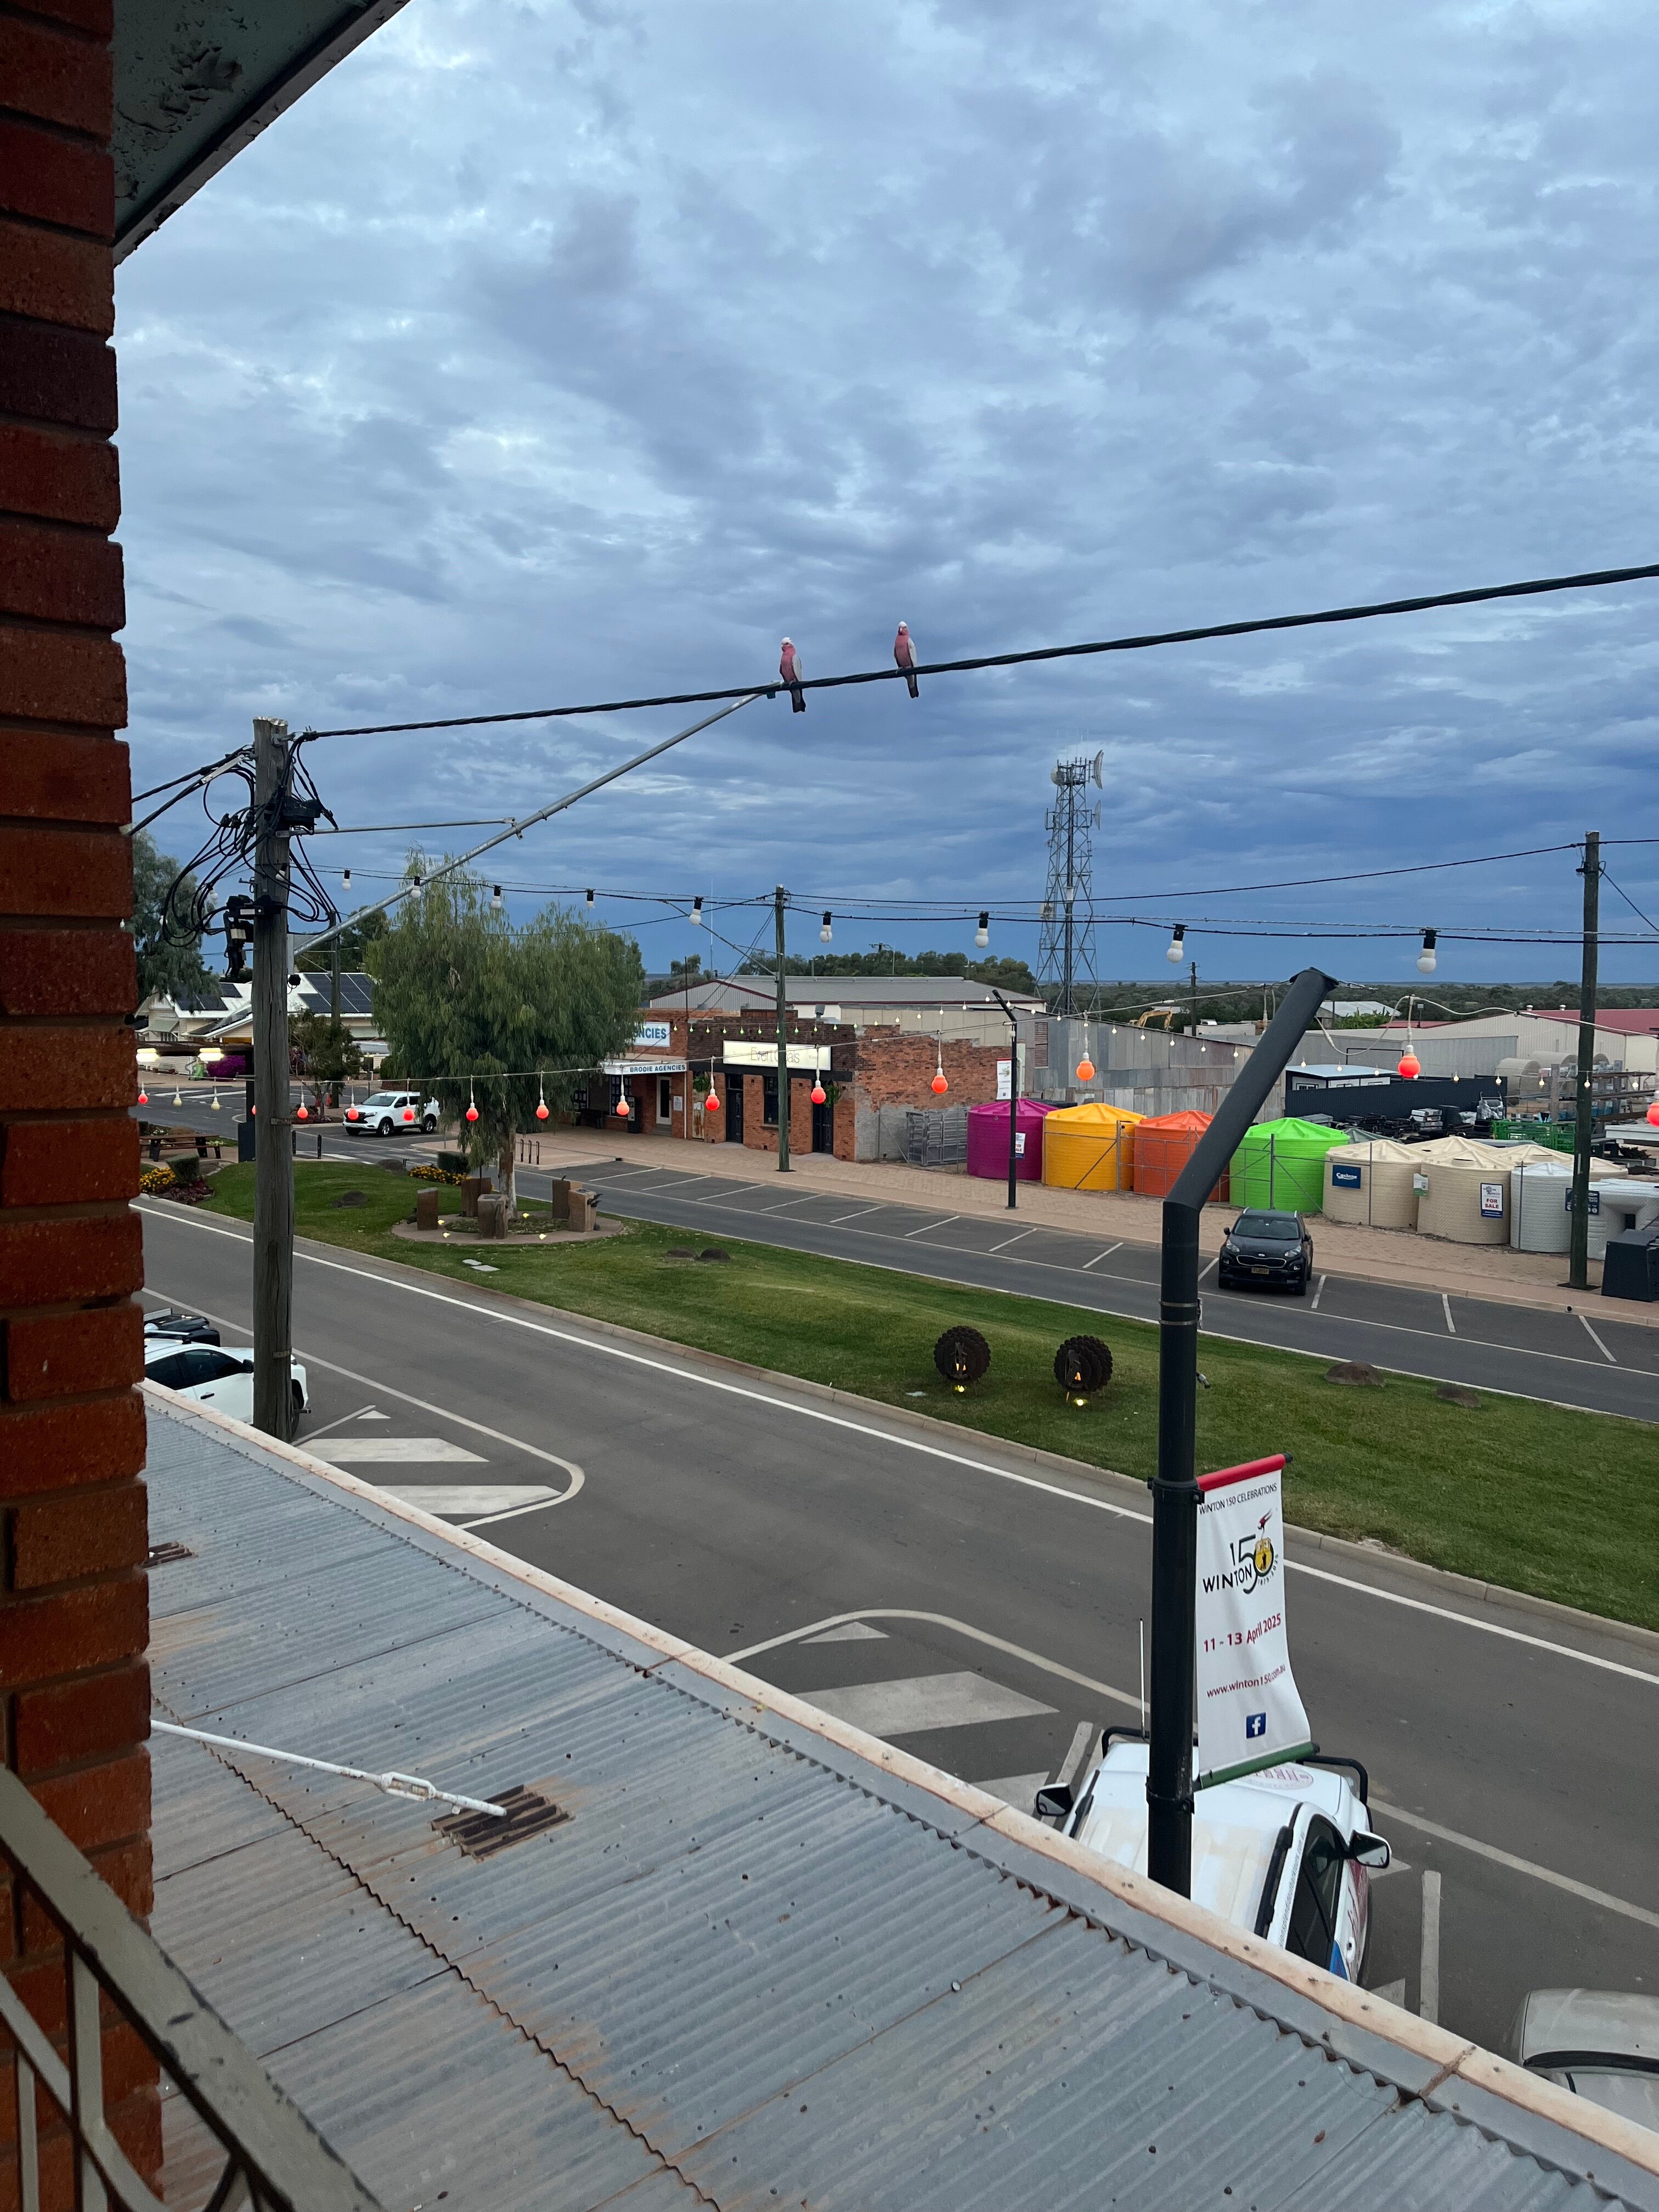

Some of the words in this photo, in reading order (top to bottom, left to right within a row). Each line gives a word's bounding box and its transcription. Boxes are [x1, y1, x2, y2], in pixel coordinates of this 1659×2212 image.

[638, 1027, 667, 1039] NCIES
[774, 1048, 799, 1063] als
[1199, 1500, 1225, 1515] WINTON
[1226, 1496, 1236, 1506] 150
[1237, 1482, 1277, 1503] CELEBRATIONS
[1203, 1563, 1252, 1593] WINTON
[1204, 1637, 1215, 1652] 11
[1227, 1632, 1242, 1645] 13
[1246, 1622, 1262, 1644] April
[1263, 1613, 1281, 1633] 2025
[1207, 1664, 1286, 1699] www.winton150.com.au
[1278, 1831, 1306, 1948] sionsplendidoutbacktours.com.au
